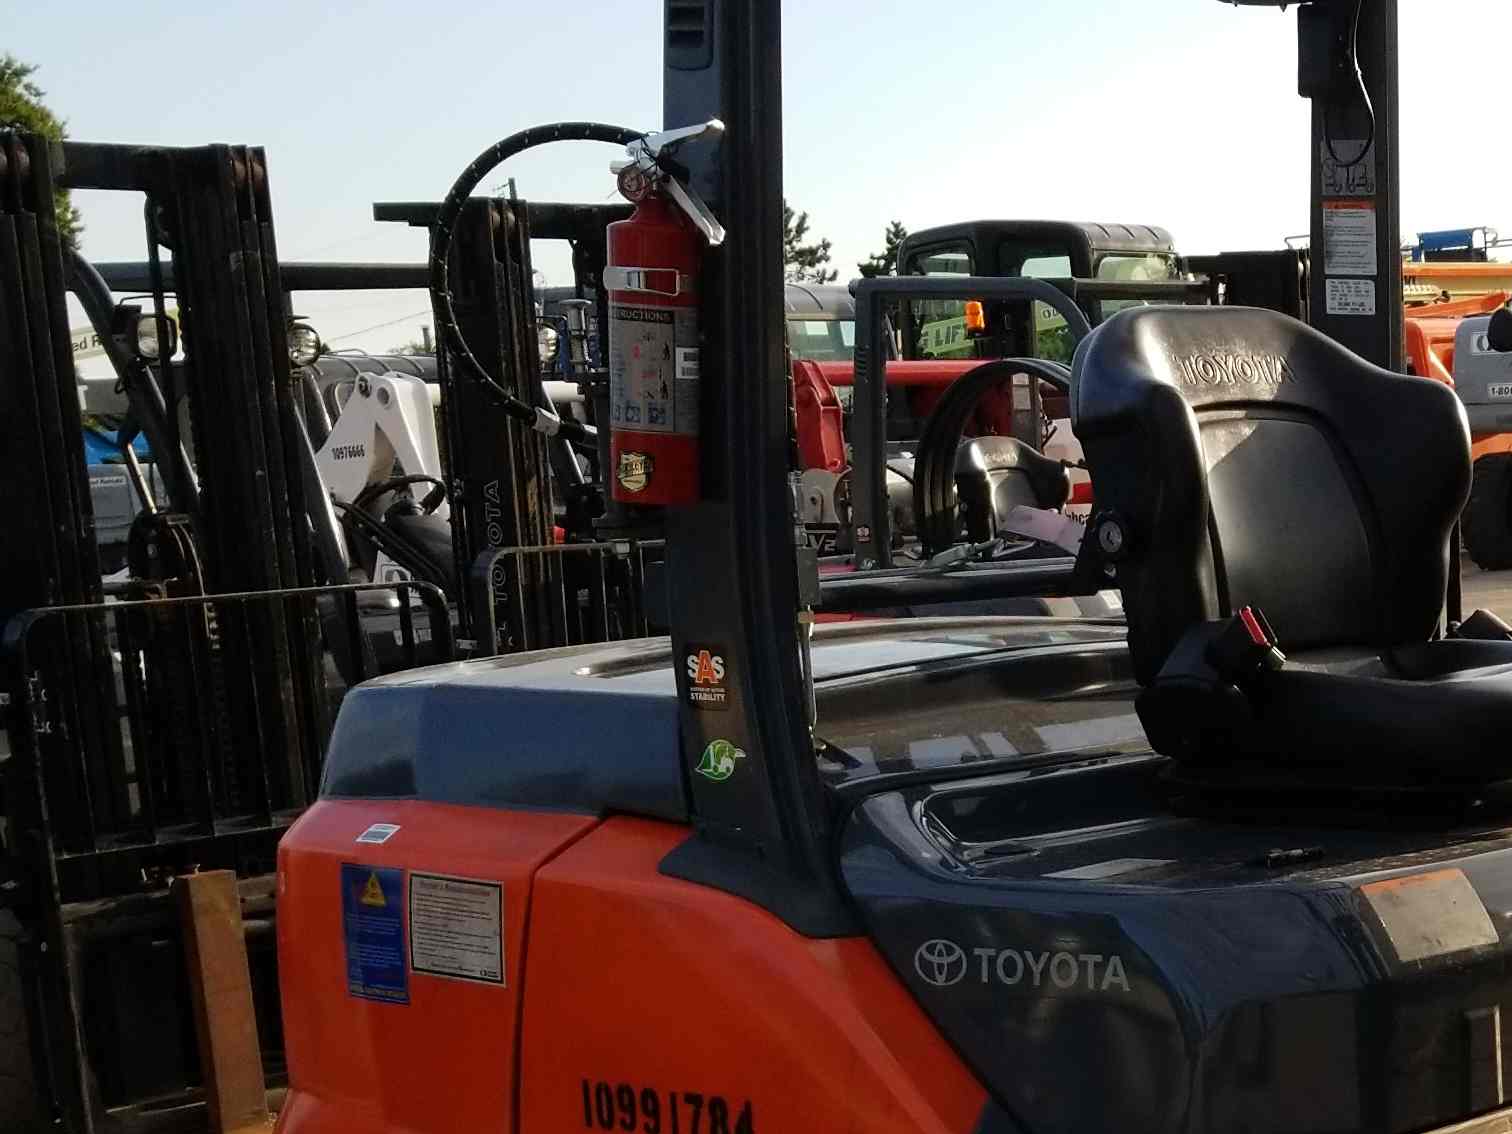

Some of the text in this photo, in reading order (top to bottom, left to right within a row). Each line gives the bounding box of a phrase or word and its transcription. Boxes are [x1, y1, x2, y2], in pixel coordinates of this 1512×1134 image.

[1172, 353, 1296, 385] TOYOTA
[483, 480, 508, 605] TOOTA
[687, 650, 726, 684] SAS
[973, 948, 1131, 991] TOYOTA
